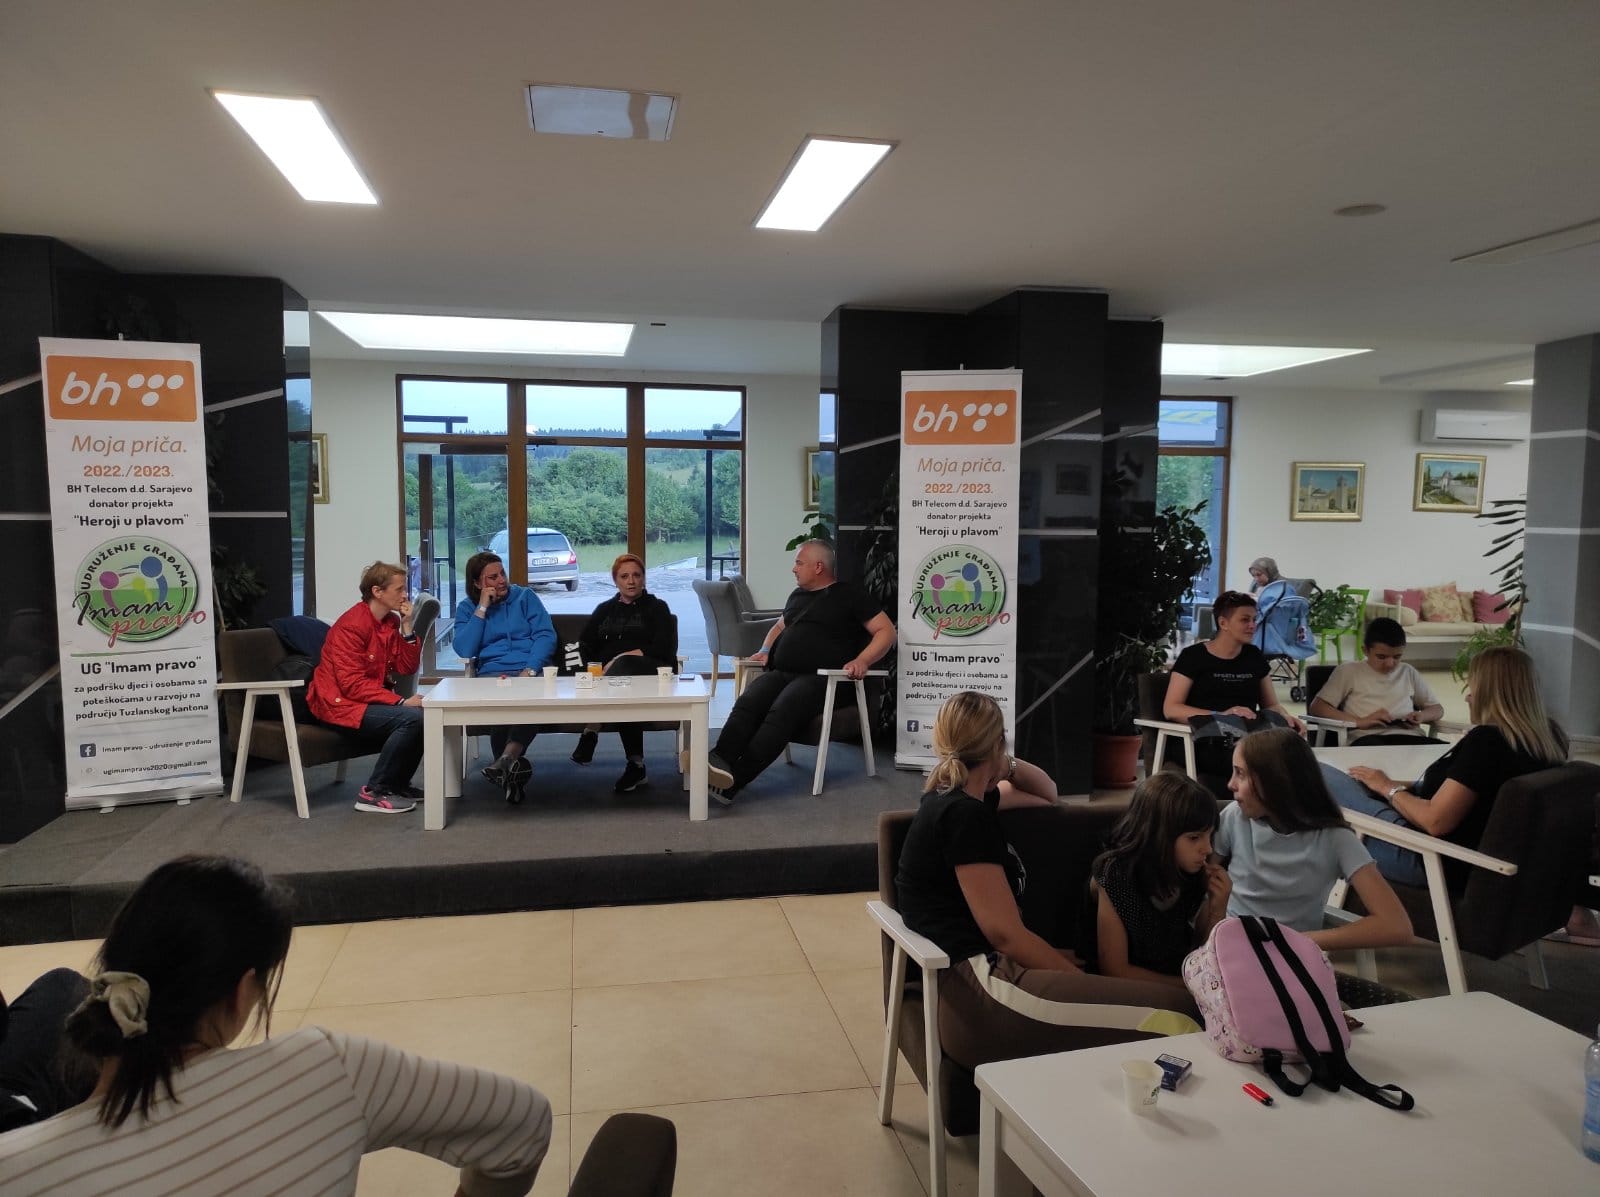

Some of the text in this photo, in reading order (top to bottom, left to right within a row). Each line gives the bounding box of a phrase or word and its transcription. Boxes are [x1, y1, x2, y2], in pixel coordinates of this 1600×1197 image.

[61, 371, 121, 406] bh
[913, 404, 958, 432] bh
[71, 435, 187, 456] Moja priča.
[83, 465, 174, 477] 2022./2023.
[917, 458, 1006, 476] Moja priča.
[67, 484, 193, 494] BH Telecom d.d. Sarajevo
[925, 484, 993, 494] 2022./2023.
[89, 500, 173, 509] donator projekta
[974, 500, 1007, 508] Sarajevo
[74, 514, 189, 528] "Heroji u plavom"
[81, 543, 188, 590] UDRUŽENJE GRAĐANA
[72, 591, 174, 625] Imam
[910, 591, 986, 619] Imam
[108, 610, 206, 649] pravo
[933, 613, 1010, 640] pravo
[912, 652, 927, 661] UG
[81, 662, 101, 674] UG
[87, 683, 124, 694] podršku
[127, 682, 148, 692] djeci
[155, 680, 195, 688] osobama
[83, 696, 144, 707] poteškoćama
[154, 693, 188, 702] razvoju
[76, 704, 209, 721] području Tuzlanskog kantona
[123, 744, 143, 753] pravo
